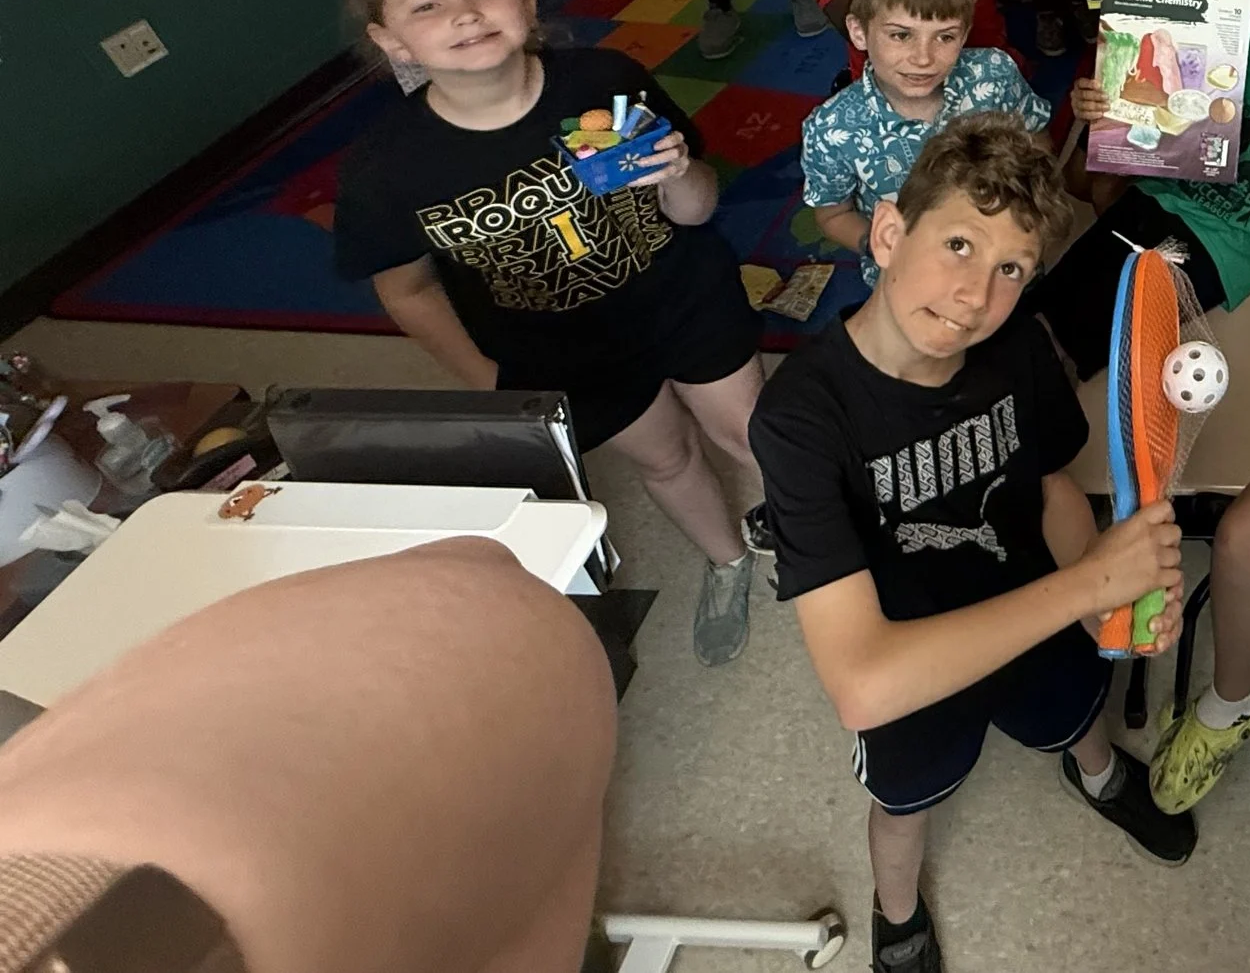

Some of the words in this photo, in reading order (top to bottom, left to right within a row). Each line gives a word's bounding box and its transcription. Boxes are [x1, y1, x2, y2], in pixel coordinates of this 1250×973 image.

[1234, 8, 1242, 16] 10
[425, 166, 582, 249] IROQU
[865, 394, 1021, 512] PUMA
